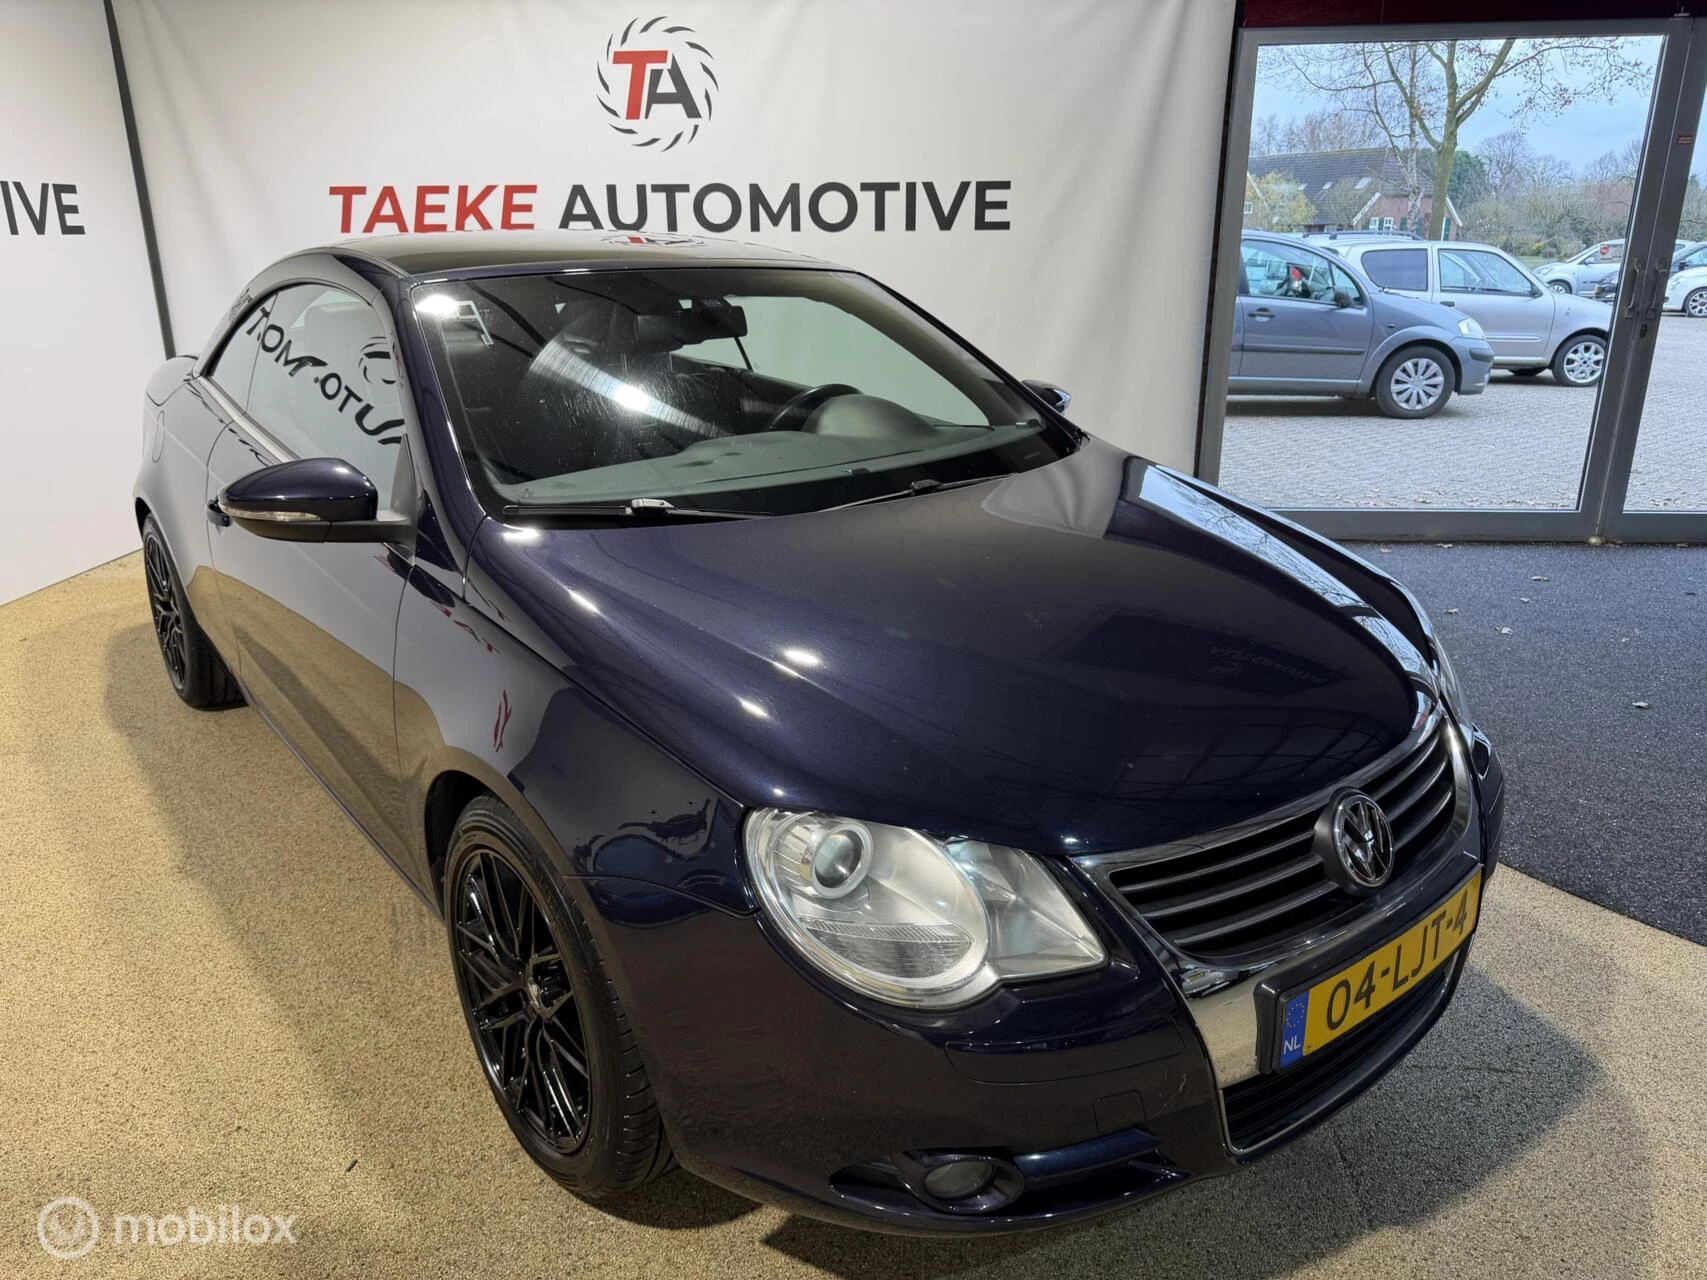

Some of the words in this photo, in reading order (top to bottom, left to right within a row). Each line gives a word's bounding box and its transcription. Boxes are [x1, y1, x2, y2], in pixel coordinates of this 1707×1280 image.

[611, 49, 702, 121] TA
[0, 180, 87, 236] IVE
[329, 183, 538, 234] TAEKE
[558, 180, 1012, 232] AUTOMOTIVE
[1326, 889, 1469, 1031] 04-LJT-4
[1283, 1034, 1302, 1056] NL
